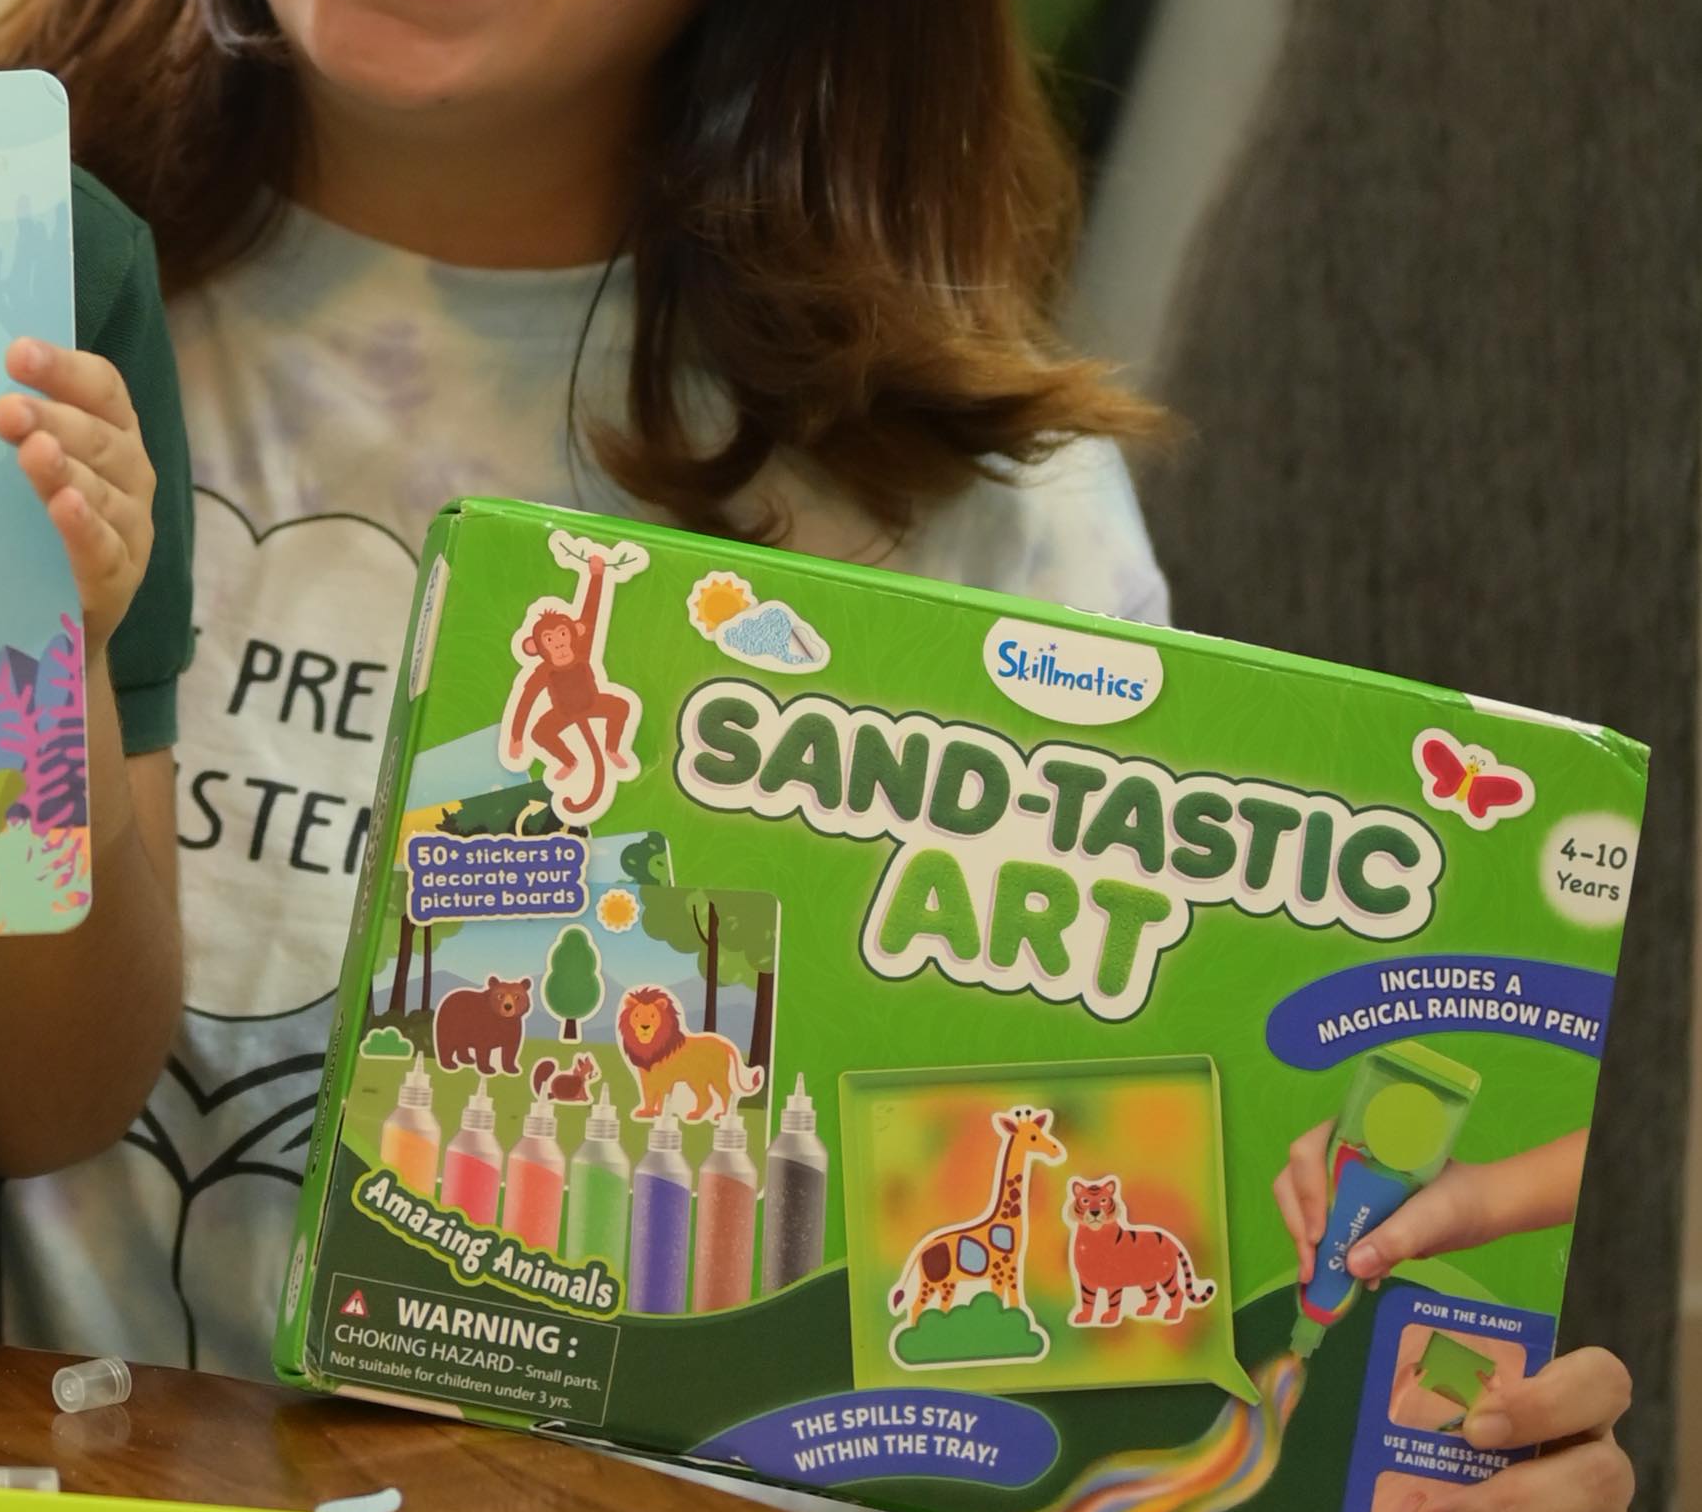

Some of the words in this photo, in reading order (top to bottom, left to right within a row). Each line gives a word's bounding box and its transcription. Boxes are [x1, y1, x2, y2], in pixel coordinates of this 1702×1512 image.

[998, 640, 1144, 702] Skillmatics
[693, 696, 1421, 914] SAND-TASTIC
[417, 845, 459, 865] 50+
[465, 848, 549, 864] stickers
[555, 846, 576, 861] to
[1560, 838, 1628, 870] 4-10
[422, 870, 518, 887] decorate
[525, 870, 572, 887] your
[1557, 870, 1620, 901] Years
[420, 893, 496, 912] picture
[502, 889, 576, 906] boards
[880, 848, 1172, 997] ART
[1380, 968, 1496, 993] INCLUDES
[1505, 975, 1522, 996] A
[1317, 999, 1423, 1045] MAGICAL
[1427, 998, 1541, 1027] RAINBOW
[1544, 1009, 1600, 1042] PEN!
[365, 1177, 492, 1274] Amazing
[492, 1245, 613, 1308] Animals
[1413, 1301, 1449, 1319] POUR
[1453, 1309, 1476, 1324] THE
[1479, 1315, 1522, 1333] SAND!
[335, 1324, 426, 1357] CHOKING
[526, 1364, 562, 1383] Small
[564, 1373, 601, 1392] parts.
[330, 1351, 355, 1368] Not
[358, 1356, 412, 1379] suitable
[414, 1365, 433, 1383] for
[436, 1372, 492, 1394] children
[494, 1383, 535, 1402] under
[537, 1390, 547, 1404] 3
[549, 1394, 572, 1410] yrs.
[792, 1412, 837, 1440] THE
[842, 1405, 917, 1429] SPILLS
[922, 1406, 978, 1433] STAY
[793, 1436, 879, 1472] WITHIN
[884, 1434, 928, 1454] THE
[933, 1435, 999, 1467] TRAY!
[1383, 1435, 1408, 1450] USE
[1411, 1439, 1435, 1455] THE
[1438, 1446, 1509, 1468] MESS-FREE
[1395, 1451, 1460, 1474] RAINBOW
